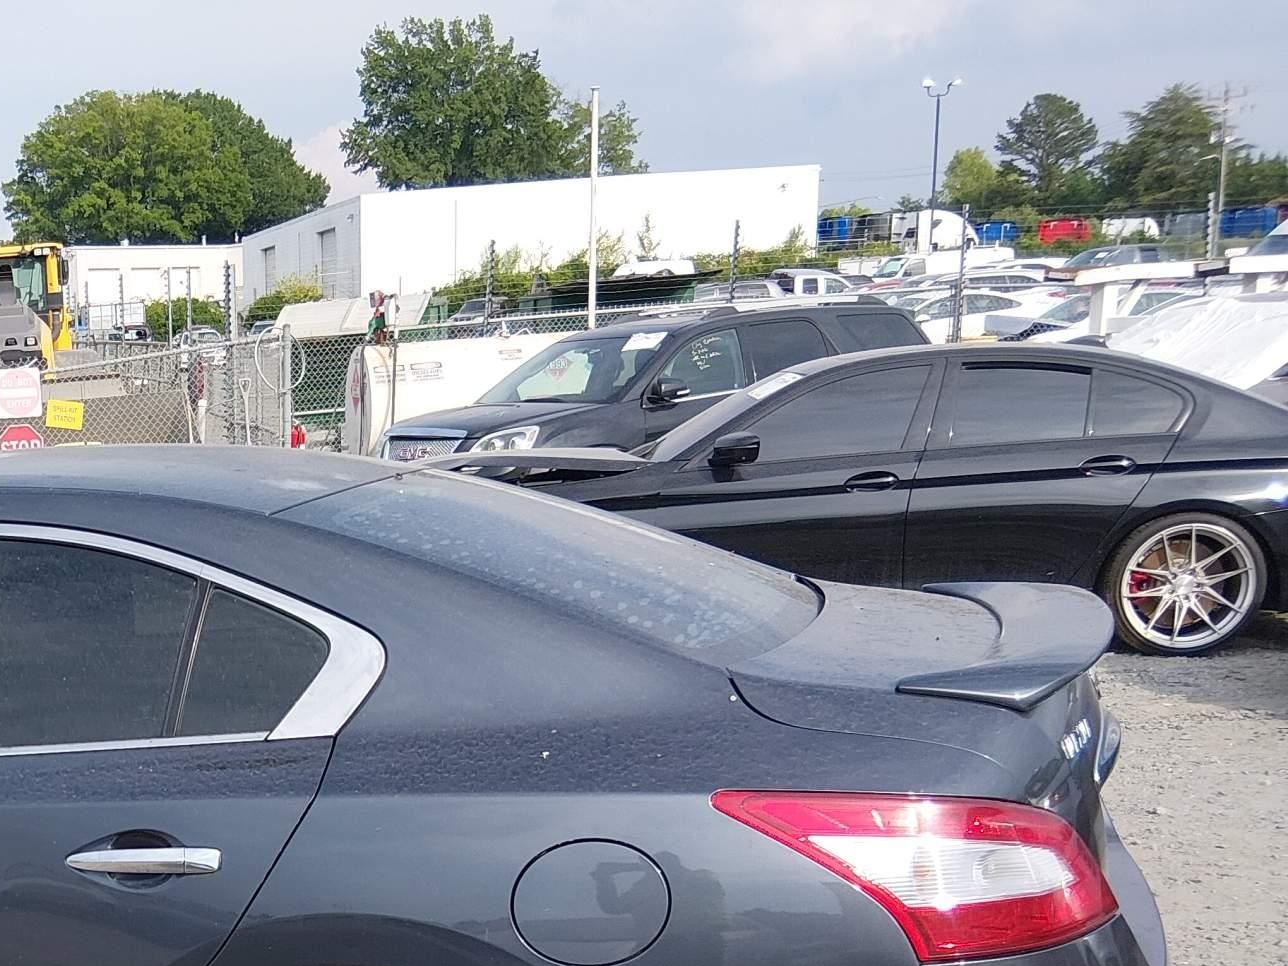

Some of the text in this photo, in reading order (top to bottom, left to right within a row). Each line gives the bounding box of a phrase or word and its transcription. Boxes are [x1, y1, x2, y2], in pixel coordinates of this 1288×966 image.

[2, 375, 32, 387] DO NOT
[6, 399, 32, 409] ENTER
[400, 445, 428, 458] GMC
